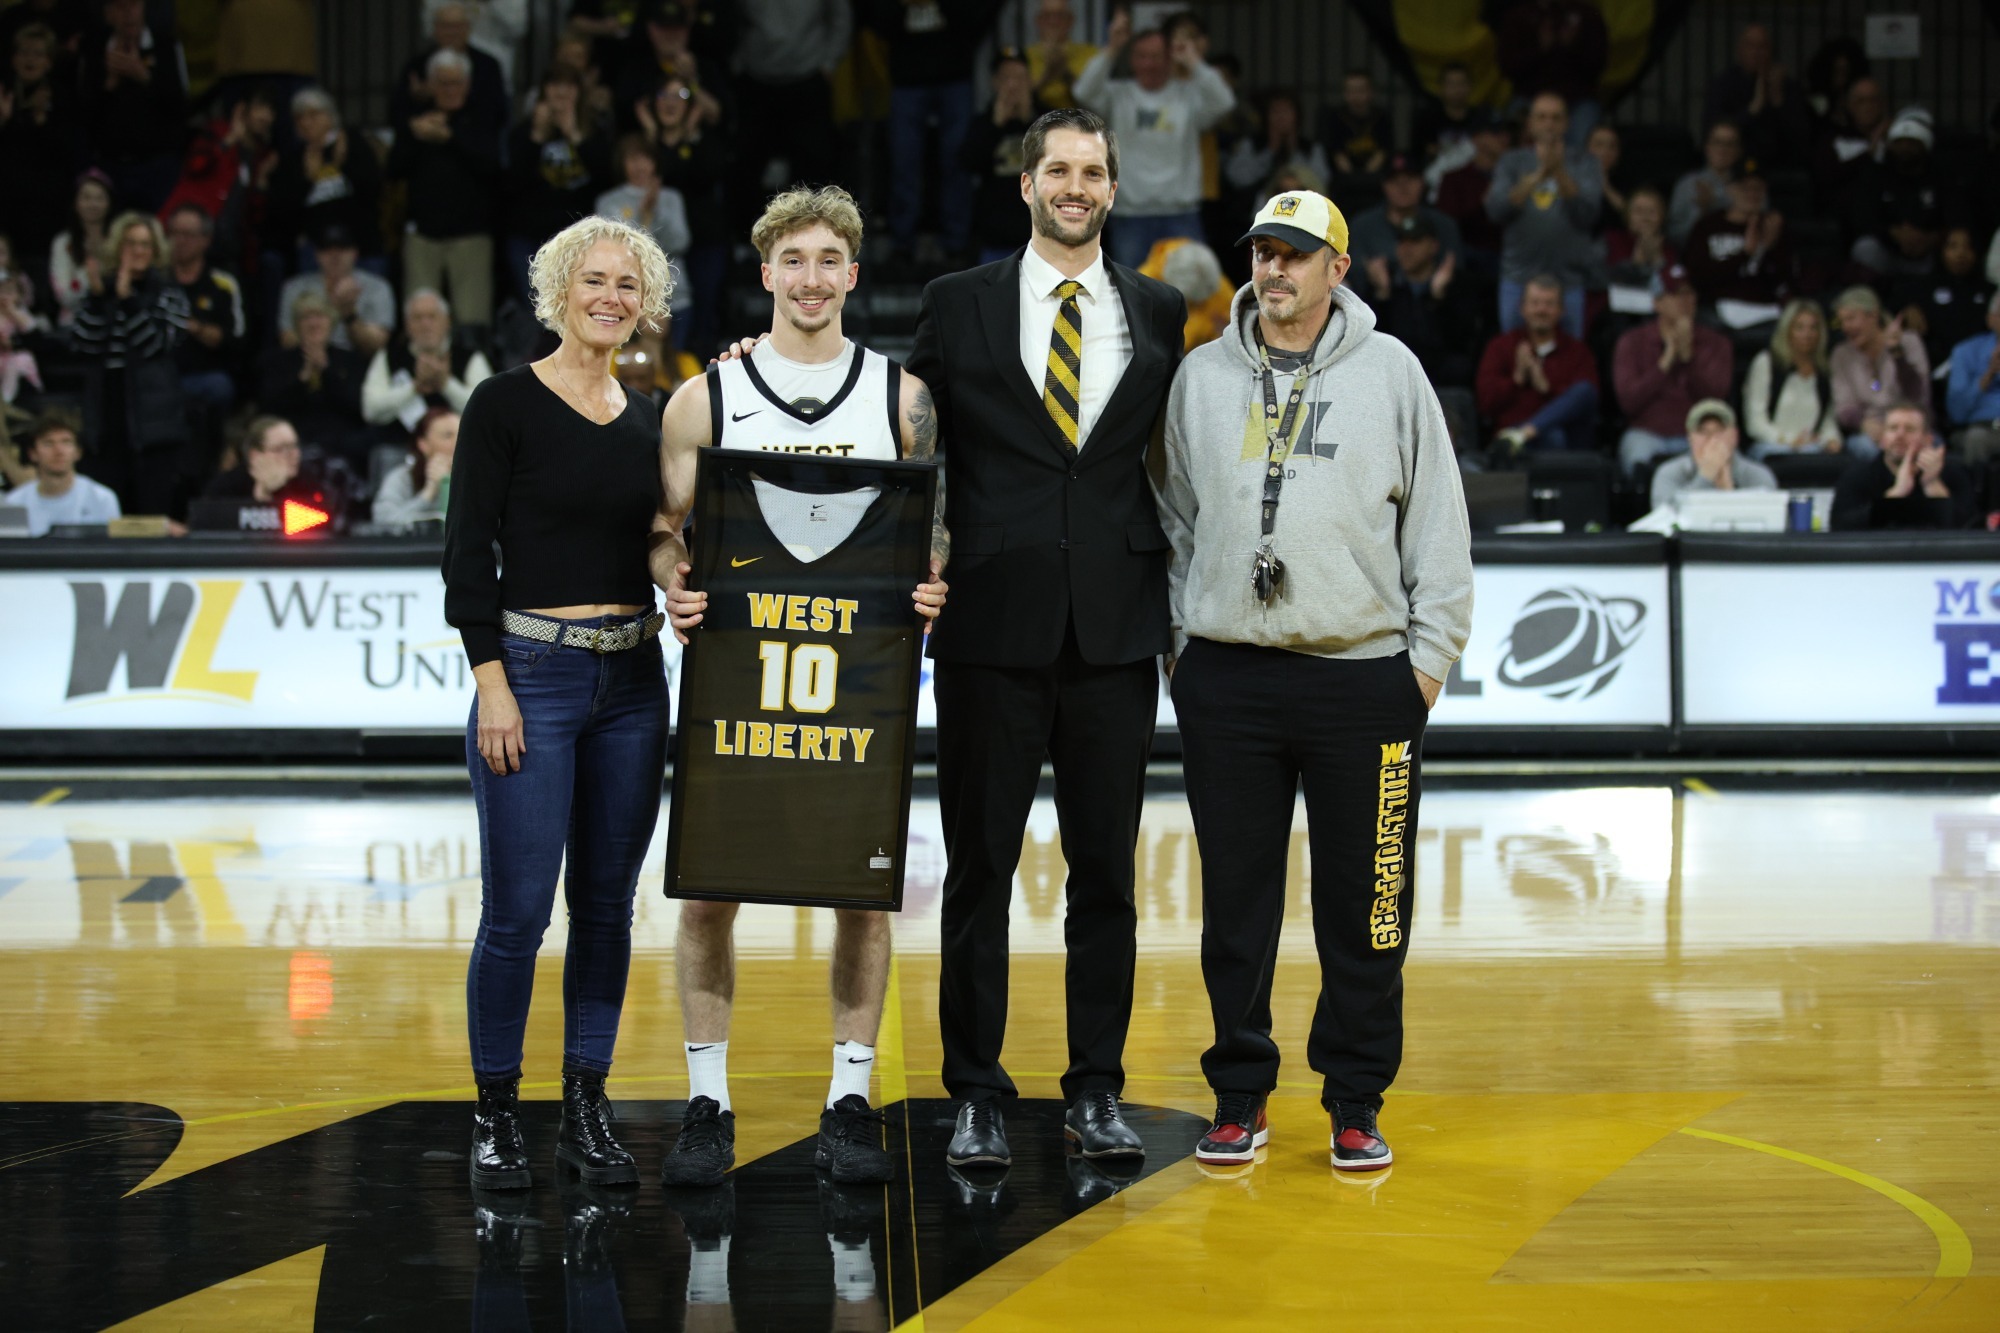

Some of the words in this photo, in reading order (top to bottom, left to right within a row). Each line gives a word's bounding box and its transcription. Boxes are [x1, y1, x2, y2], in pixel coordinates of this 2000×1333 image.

[65, 581, 260, 702] WL
[258, 581, 418, 630] WEST
[747, 592, 858, 634] WEST
[759, 640, 838, 713] 10
[714, 719, 874, 763] LIBERTY
[1380, 740, 1412, 766] WL
[1370, 761, 1410, 950] HILLTOPPERS
